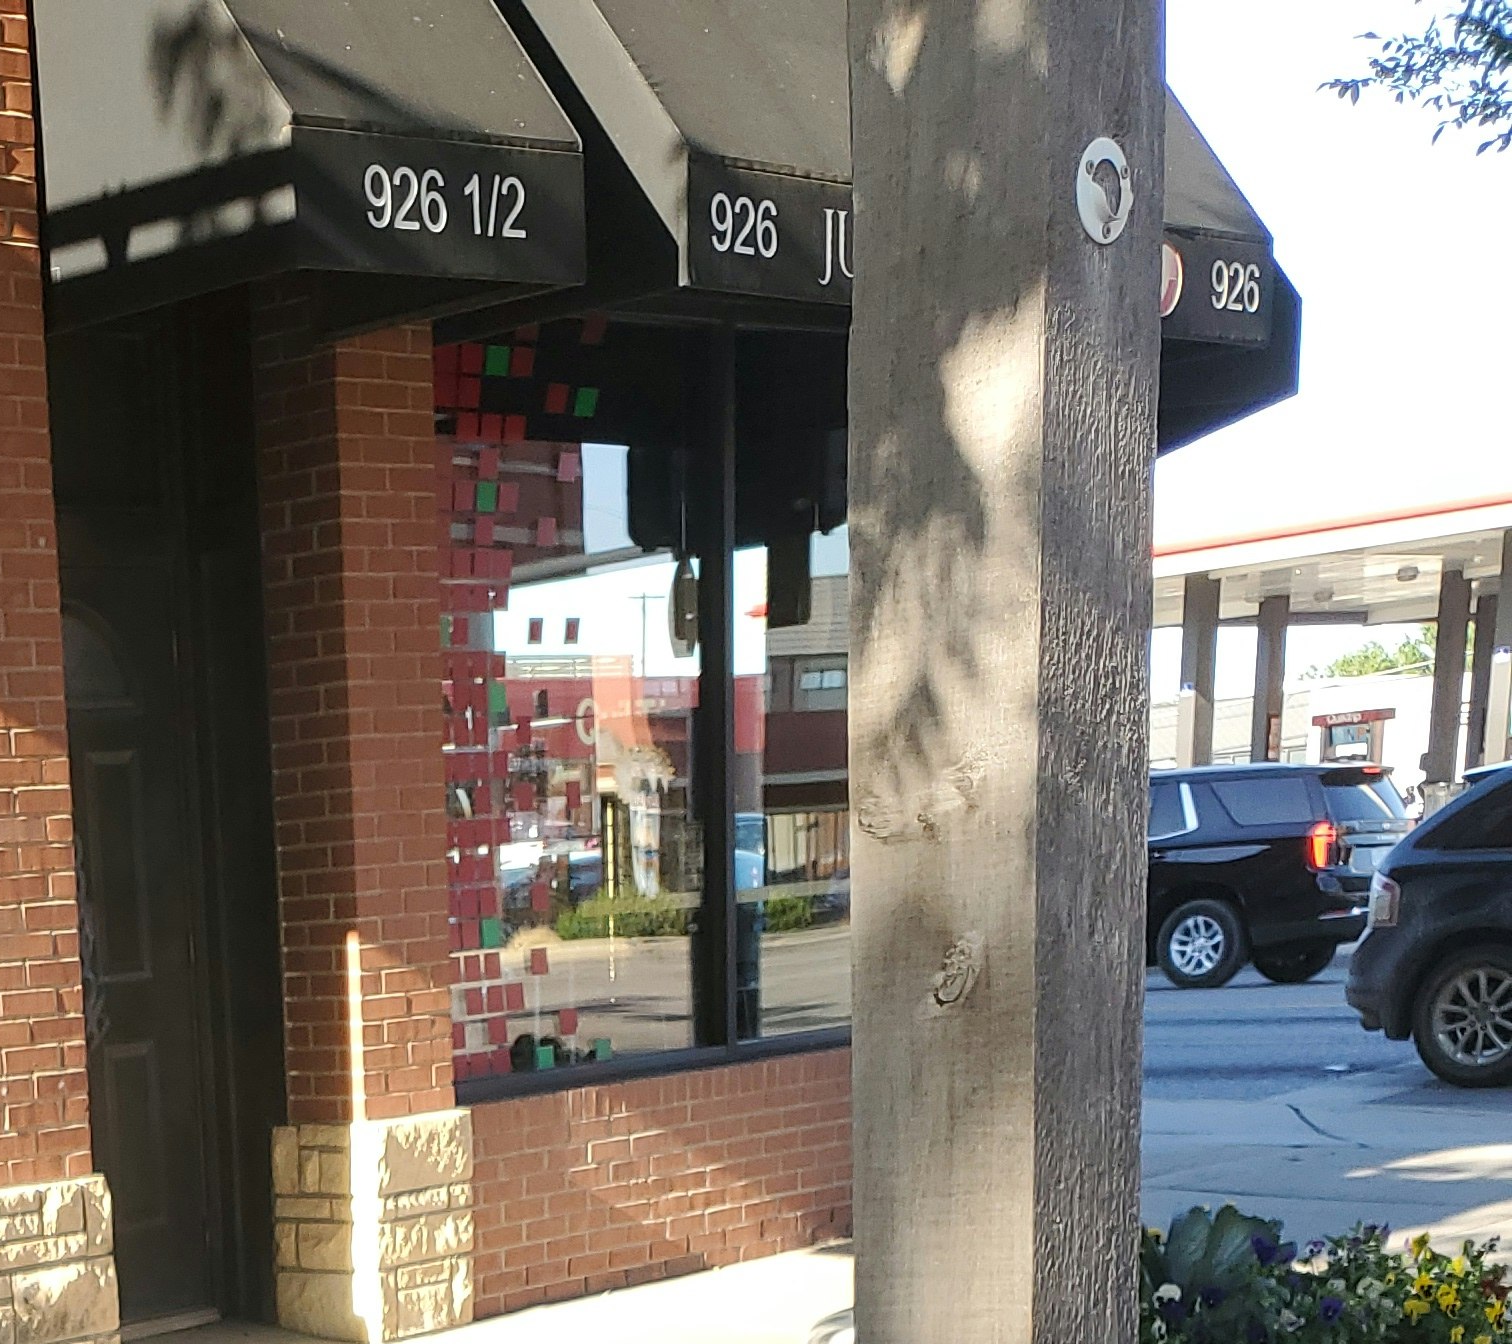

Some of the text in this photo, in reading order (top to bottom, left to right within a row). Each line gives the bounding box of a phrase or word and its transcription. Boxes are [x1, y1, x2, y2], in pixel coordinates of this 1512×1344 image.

[363, 163, 528, 240] 926 1/2
[710, 191, 779, 259] 926
[1210, 259, 1260, 313] 926
